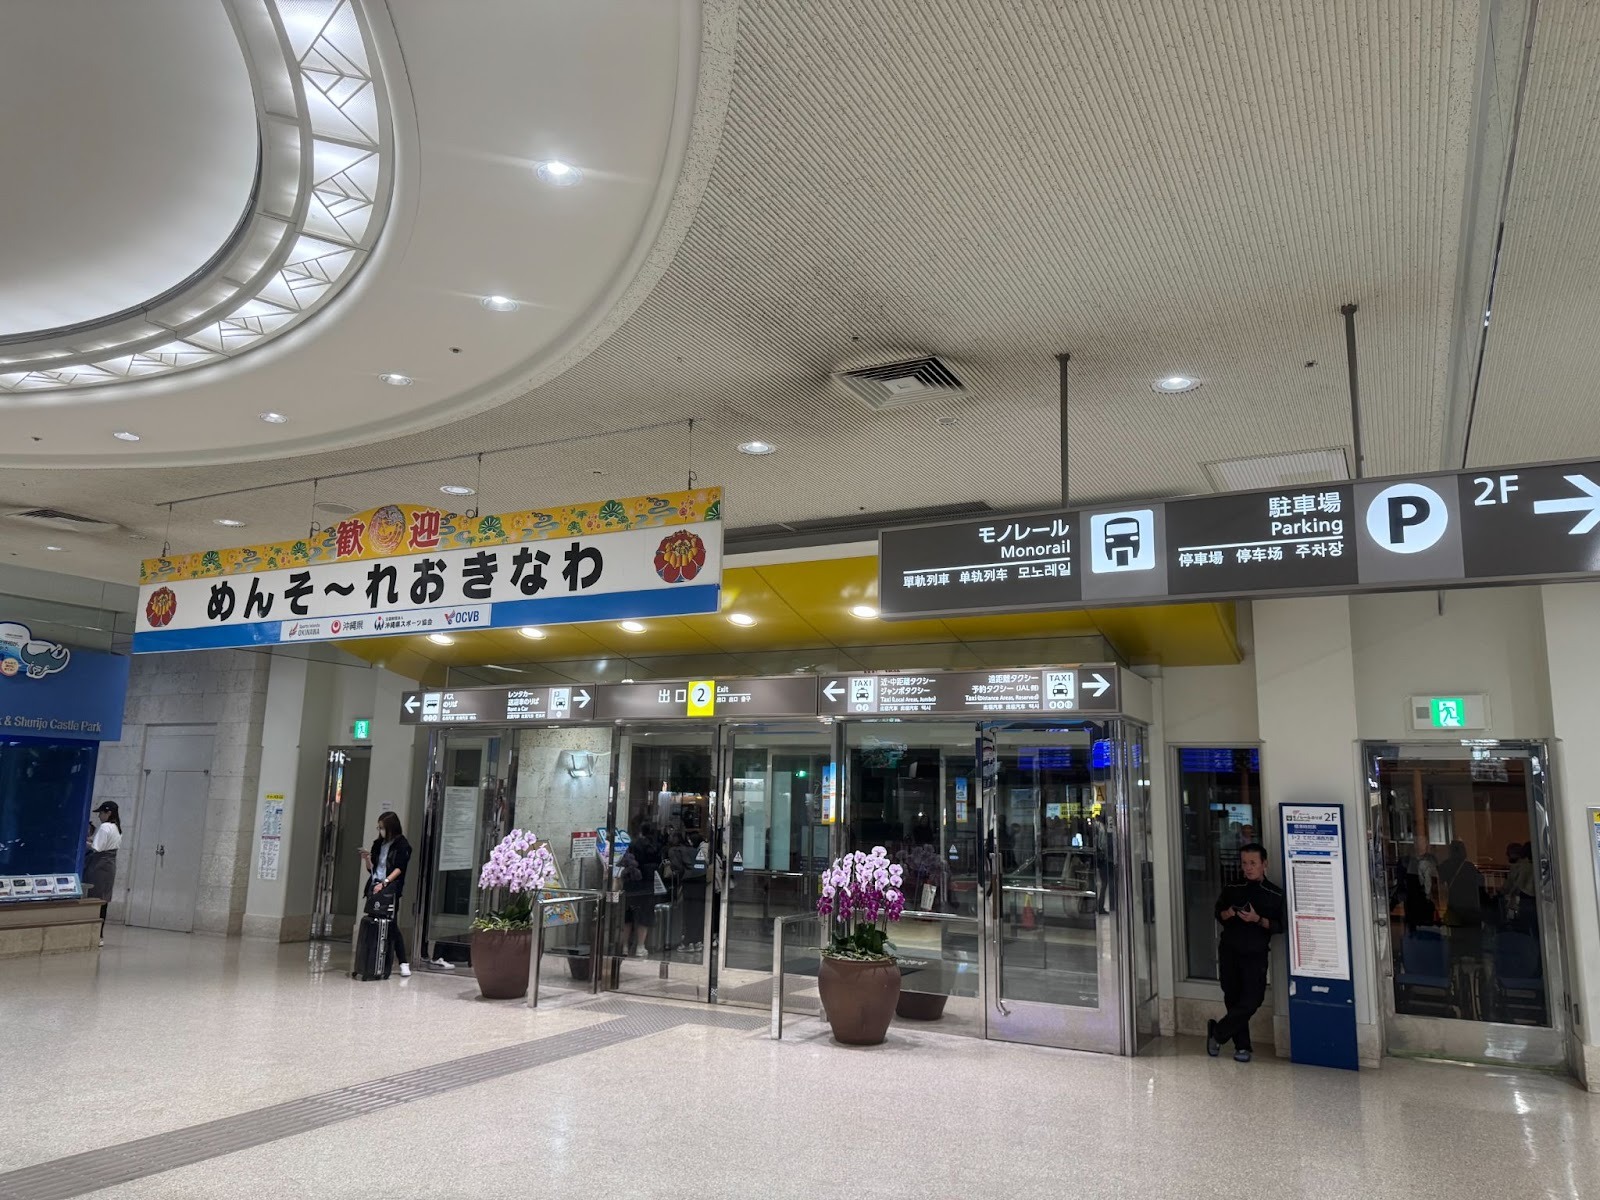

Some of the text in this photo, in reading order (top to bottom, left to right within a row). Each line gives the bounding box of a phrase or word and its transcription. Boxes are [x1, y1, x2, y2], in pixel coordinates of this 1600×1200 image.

[1473, 474, 1519, 506] 2F
[1268, 491, 1342, 518] 駐車場
[408, 508, 443, 549] 迎
[1271, 518, 1344, 536] Parking
[1387, 495, 1431, 544] P
[978, 519, 1070, 543] モノレール
[1001, 539, 1071, 558] Monorail
[1178, 541, 1344, 567] 停車場 停车场 주차장
[903, 562, 1071, 588] 單軌列車 单轨列车 모노레일
[455, 611, 480, 623] OCVB
[1049, 674, 1071, 682] TAXI
[508, 690, 533, 698] レンタカー
[658, 688, 687, 703] 出口
[697, 687, 705, 702] 2
[716, 685, 729, 693] Exit
[4, 715, 12, 726] &
[14, 716, 48, 731] Shurijo
[50, 719, 79, 731] Castle
[81, 720, 101, 732] Park
[1324, 812, 1338, 822] 2F
